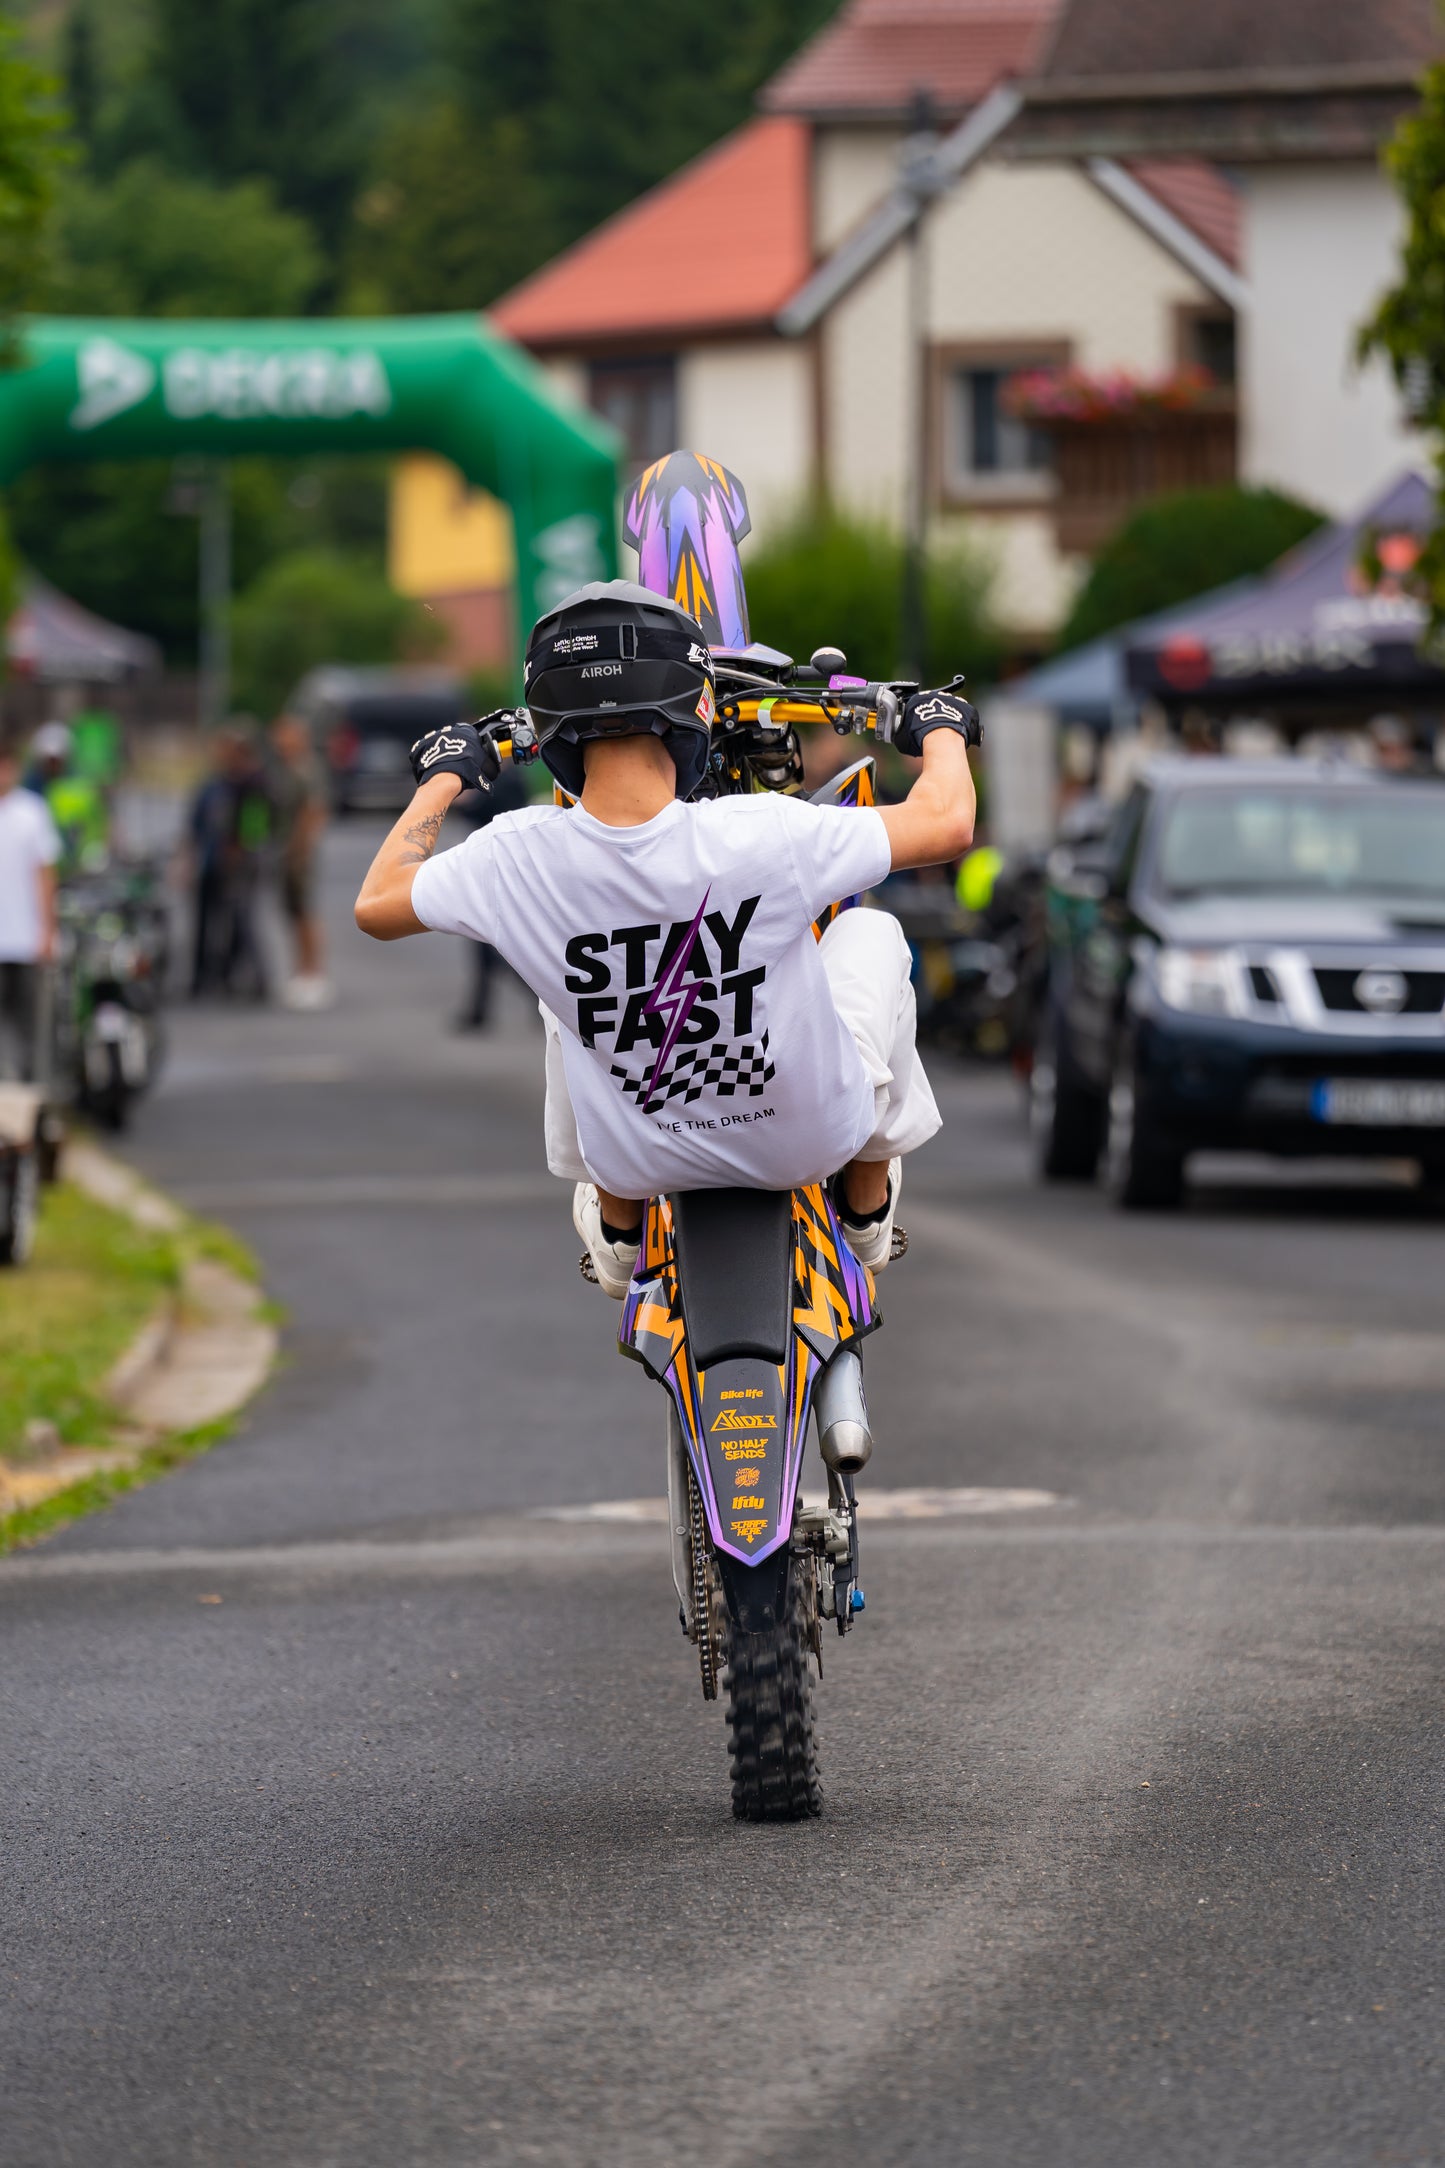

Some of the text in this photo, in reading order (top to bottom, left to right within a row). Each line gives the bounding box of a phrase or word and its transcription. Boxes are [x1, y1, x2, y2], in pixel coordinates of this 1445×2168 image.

[581, 664, 623, 678] AIROH
[565, 895, 762, 994] STAY
[577, 965, 766, 1054] FAST
[657, 1108, 775, 1132] IVE THE DREAM
[720, 1388, 764, 1400] Bike life
[720, 1438, 769, 1451] NO HALF
[725, 1449, 766, 1461] SENDS
[730, 1519, 768, 1530] SCRAPE
[737, 1527, 762, 1536] HERE
